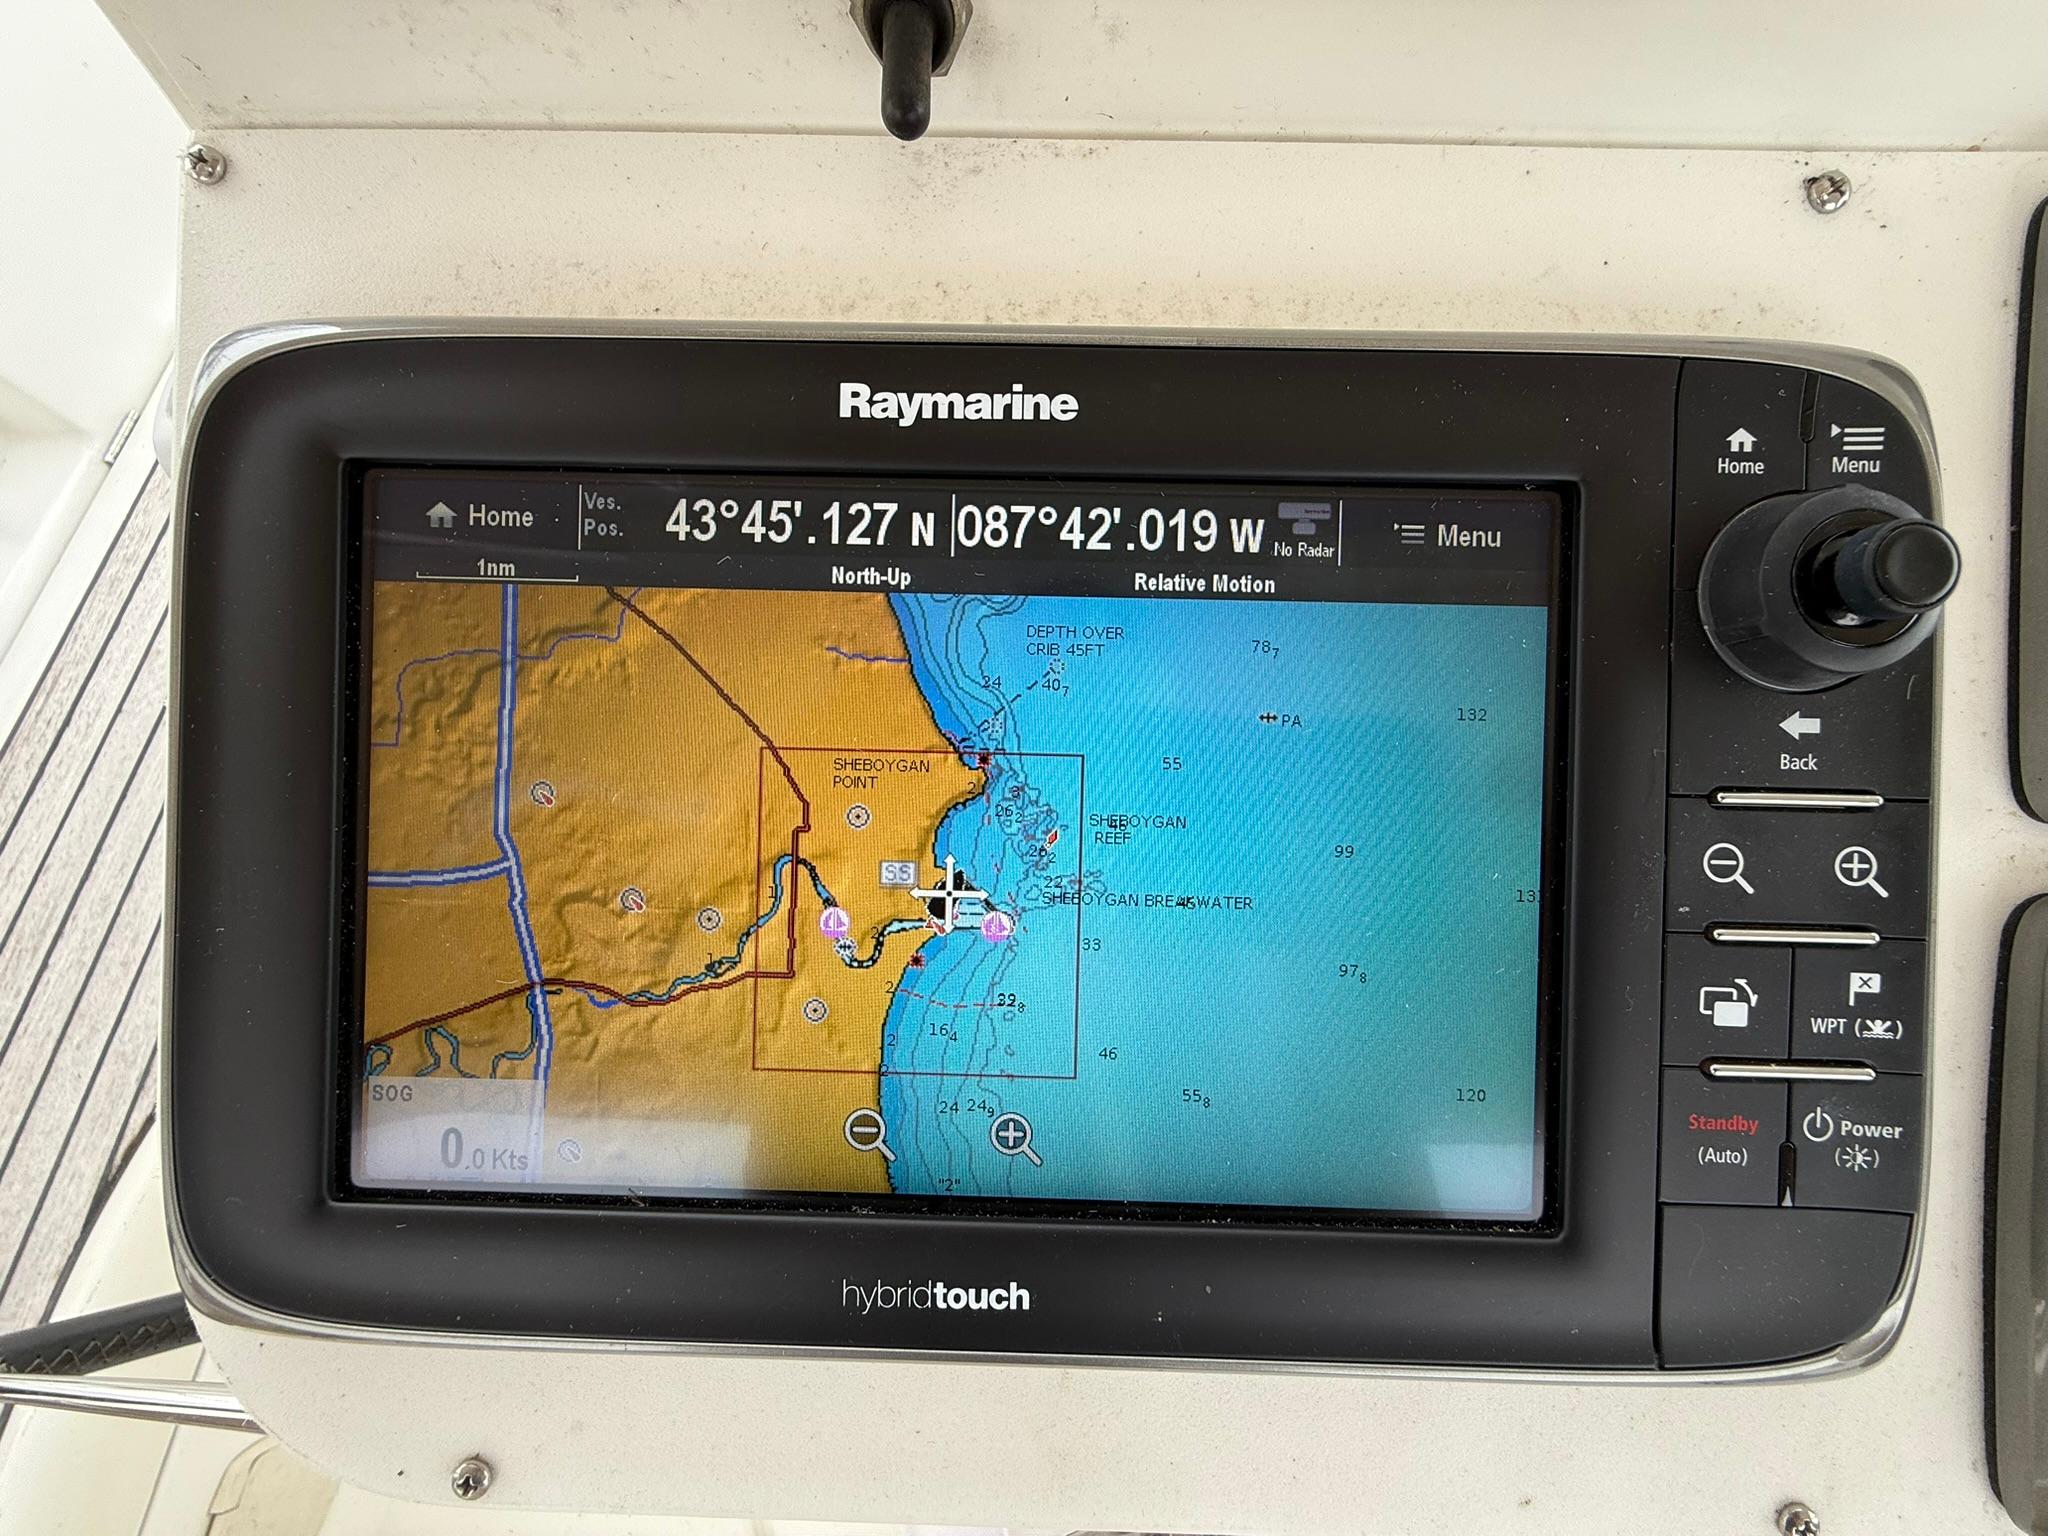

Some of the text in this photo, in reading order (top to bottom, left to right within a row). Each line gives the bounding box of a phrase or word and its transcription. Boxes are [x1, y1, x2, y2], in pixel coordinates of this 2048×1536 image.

[839, 382, 1079, 427] Raymarine
[1717, 458, 1765, 475] Home
[1831, 456, 1881, 473] Menu
[584, 491, 622, 511] Ves.
[468, 504, 534, 527] Home
[584, 518, 624, 537] Pos.
[911, 512, 935, 547] N
[1230, 518, 1265, 553] W
[1437, 526, 1502, 549] Menu
[1274, 541, 1336, 558] No Radar
[477, 558, 516, 577] 1nm
[831, 566, 912, 590] North-Up
[1134, 572, 1276, 594] Relative Motion
[1027, 625, 1125, 640] DEPTH OVER
[1026, 642, 1105, 657] CRIB 45FT
[1281, 714, 1302, 728] PA
[1457, 708, 1487, 722] 132
[833, 758, 930, 773] SHEBOYGAN
[1162, 757, 1182, 771] 55
[1780, 753, 1818, 771] Back
[833, 776, 878, 789] POINT
[967, 782, 976, 795] 2
[1089, 814, 1187, 829] SHEBOYGAN
[1094, 831, 1132, 845] REEF
[1334, 845, 1354, 858] 99
[884, 864, 911, 882] SS
[1042, 891, 1139, 907] SHEBOYGAN
[1082, 938, 1101, 951] 33
[1810, 1017, 1847, 1035] WPT
[1098, 1047, 1118, 1060] 46
[372, 1085, 413, 1101] SOG
[1456, 1089, 1486, 1103] 120
[939, 1101, 959, 1114] 24
[1688, 1114, 1759, 1135] Standby
[1840, 1120, 1903, 1139] Power
[492, 1149, 529, 1171] Kts
[1698, 1147, 1748, 1166] (Auto)
[843, 1279, 1030, 1314] hybridtouch
